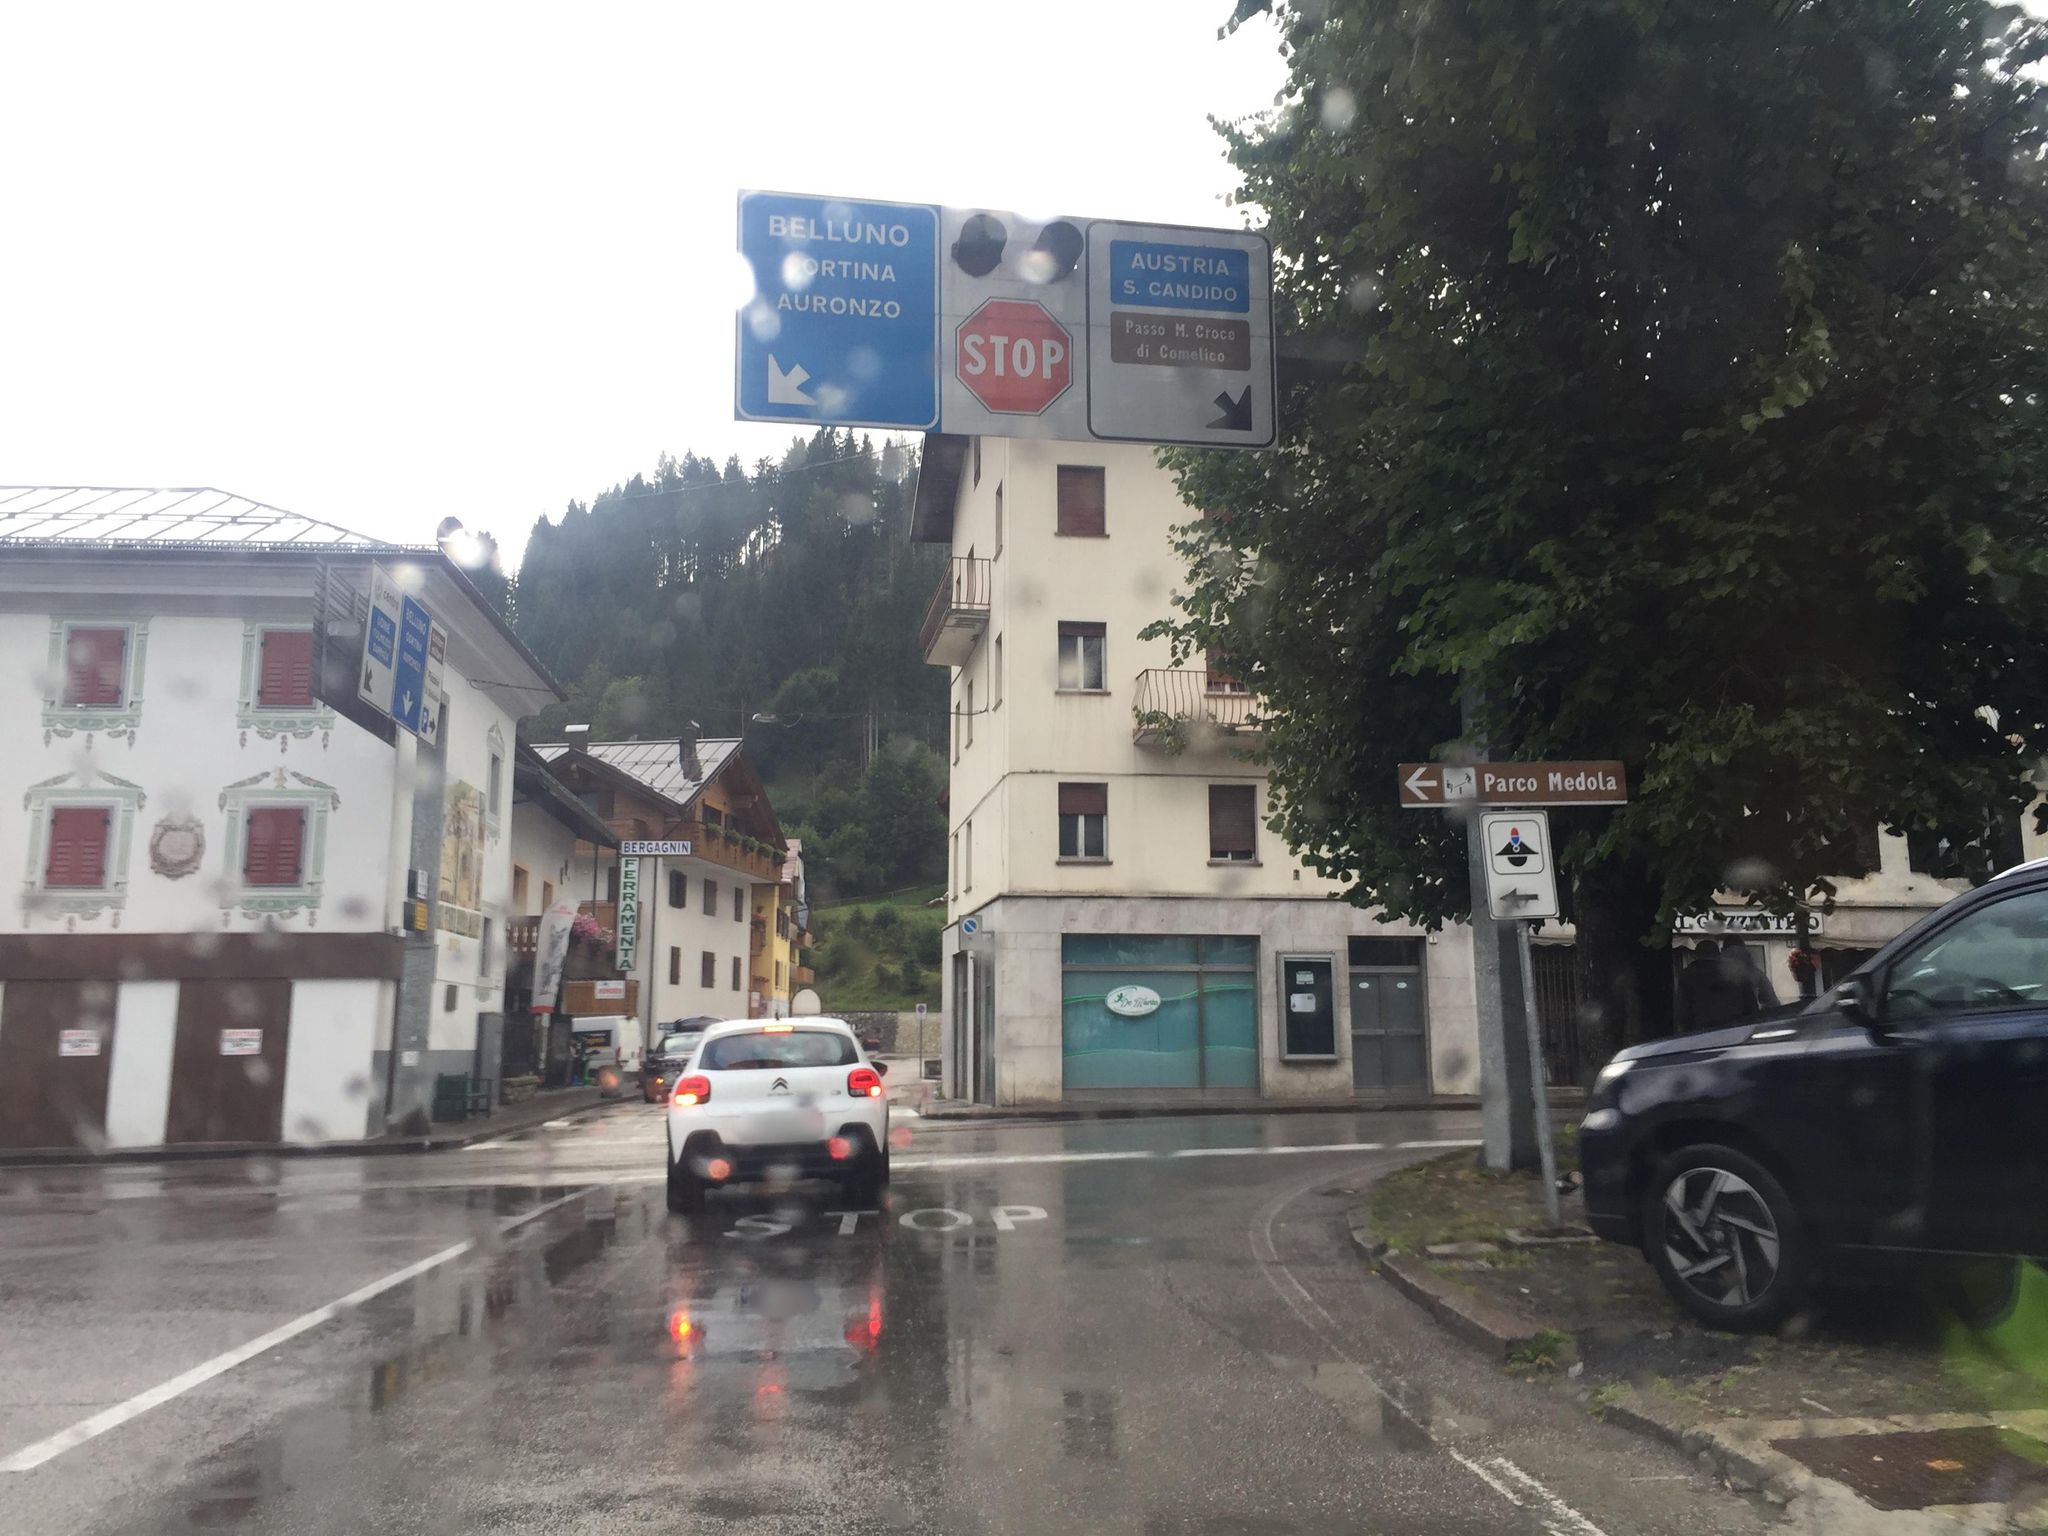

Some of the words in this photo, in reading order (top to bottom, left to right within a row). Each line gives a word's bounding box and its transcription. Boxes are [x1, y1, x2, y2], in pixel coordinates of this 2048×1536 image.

[769, 215, 910, 247] BELLUNO
[788, 256, 896, 283] ORTINA
[1131, 252, 1230, 276] AUSTRIA
[1123, 279, 1140, 295] S.
[1148, 281, 1238, 302] CANDIDO
[777, 292, 901, 319] AURONZO
[1125, 319, 1166, 337] Passo
[1175, 322, 1189, 338] M.
[1195, 324, 1236, 341] Croce
[963, 334, 1064, 379] STOP
[1137, 343, 1149, 358] di
[1160, 344, 1225, 362] Comelico
[1484, 772, 1538, 793] Parco
[1548, 771, 1618, 792] Medola
[623, 842, 689, 853] BERGAGNIN
[619, 858, 637, 969] FERRAMENTA
[723, 1204, 1048, 1241] STOP
